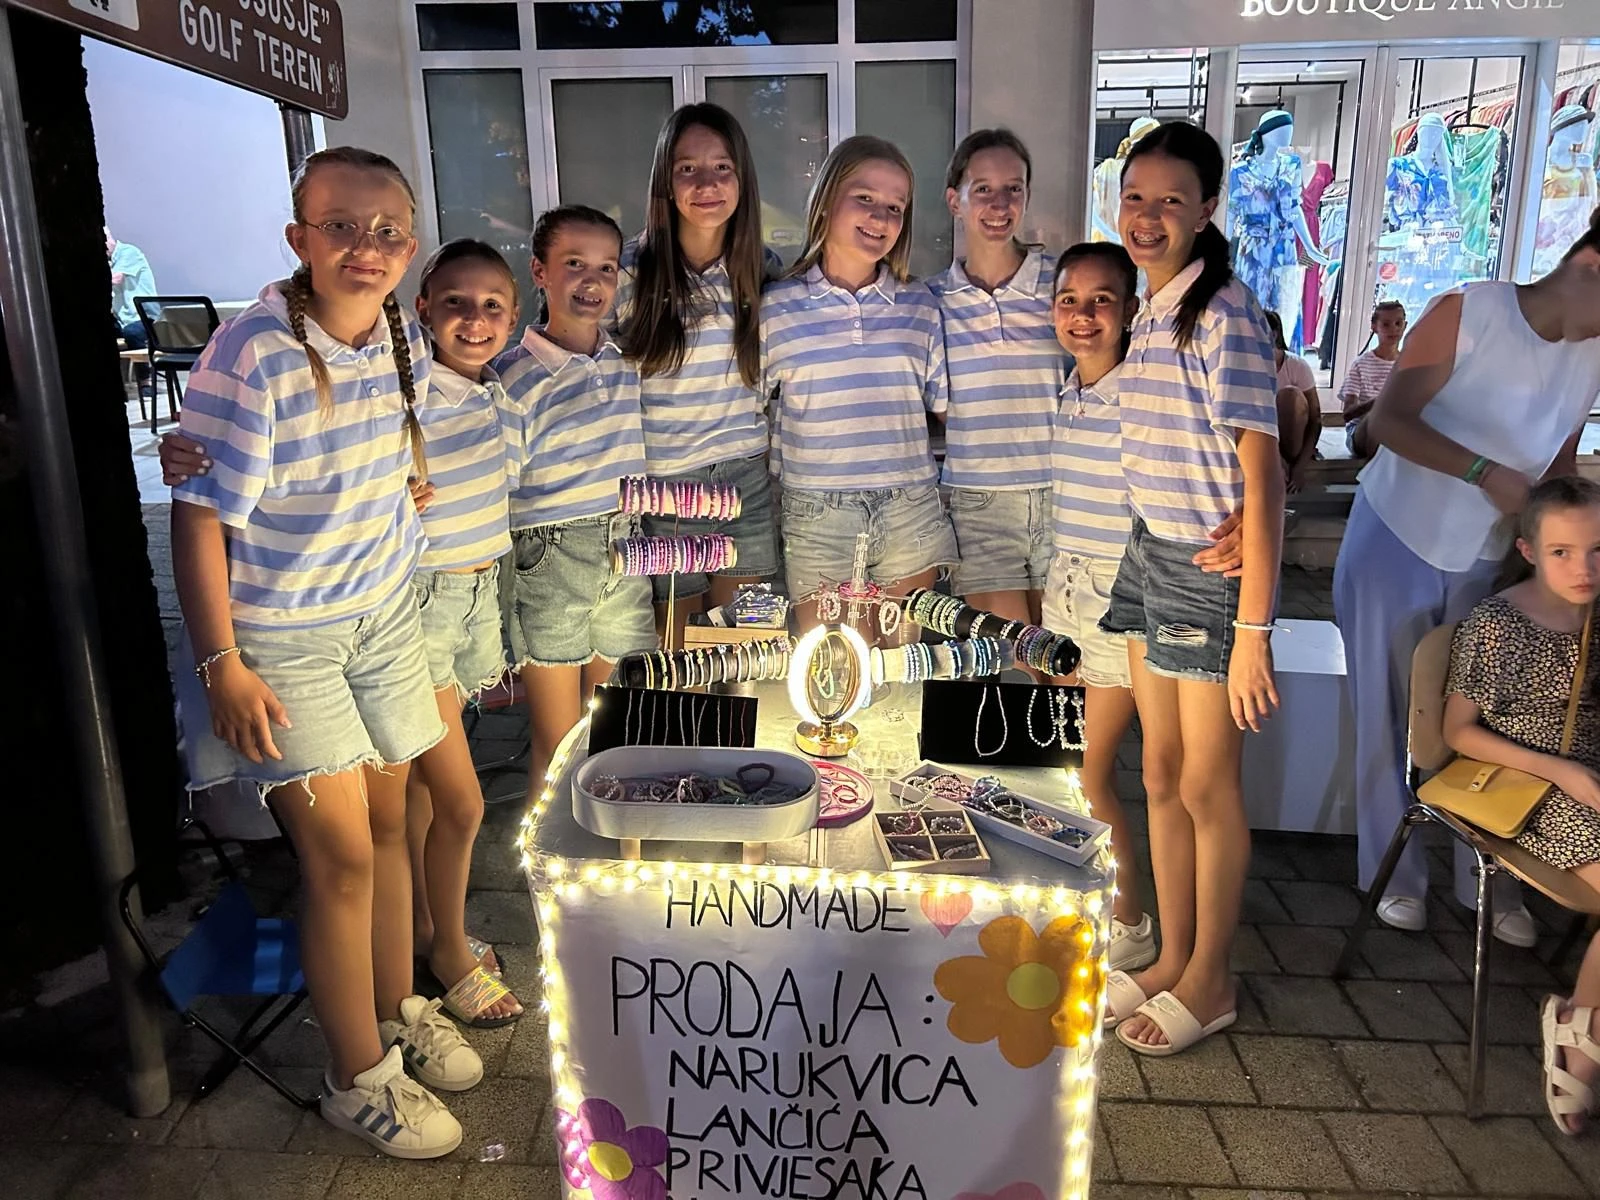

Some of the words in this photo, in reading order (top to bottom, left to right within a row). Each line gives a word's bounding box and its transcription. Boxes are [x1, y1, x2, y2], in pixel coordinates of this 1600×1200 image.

[180, 0, 243, 62] GOLF
[253, 28, 322, 95] TEREN
[666, 879, 911, 932] HANDMADE
[669, 1044, 978, 1107] NARUKVICA
[666, 1097, 890, 1154] LANČIĆA
[666, 1147, 928, 1200] PRIVJESAKA
